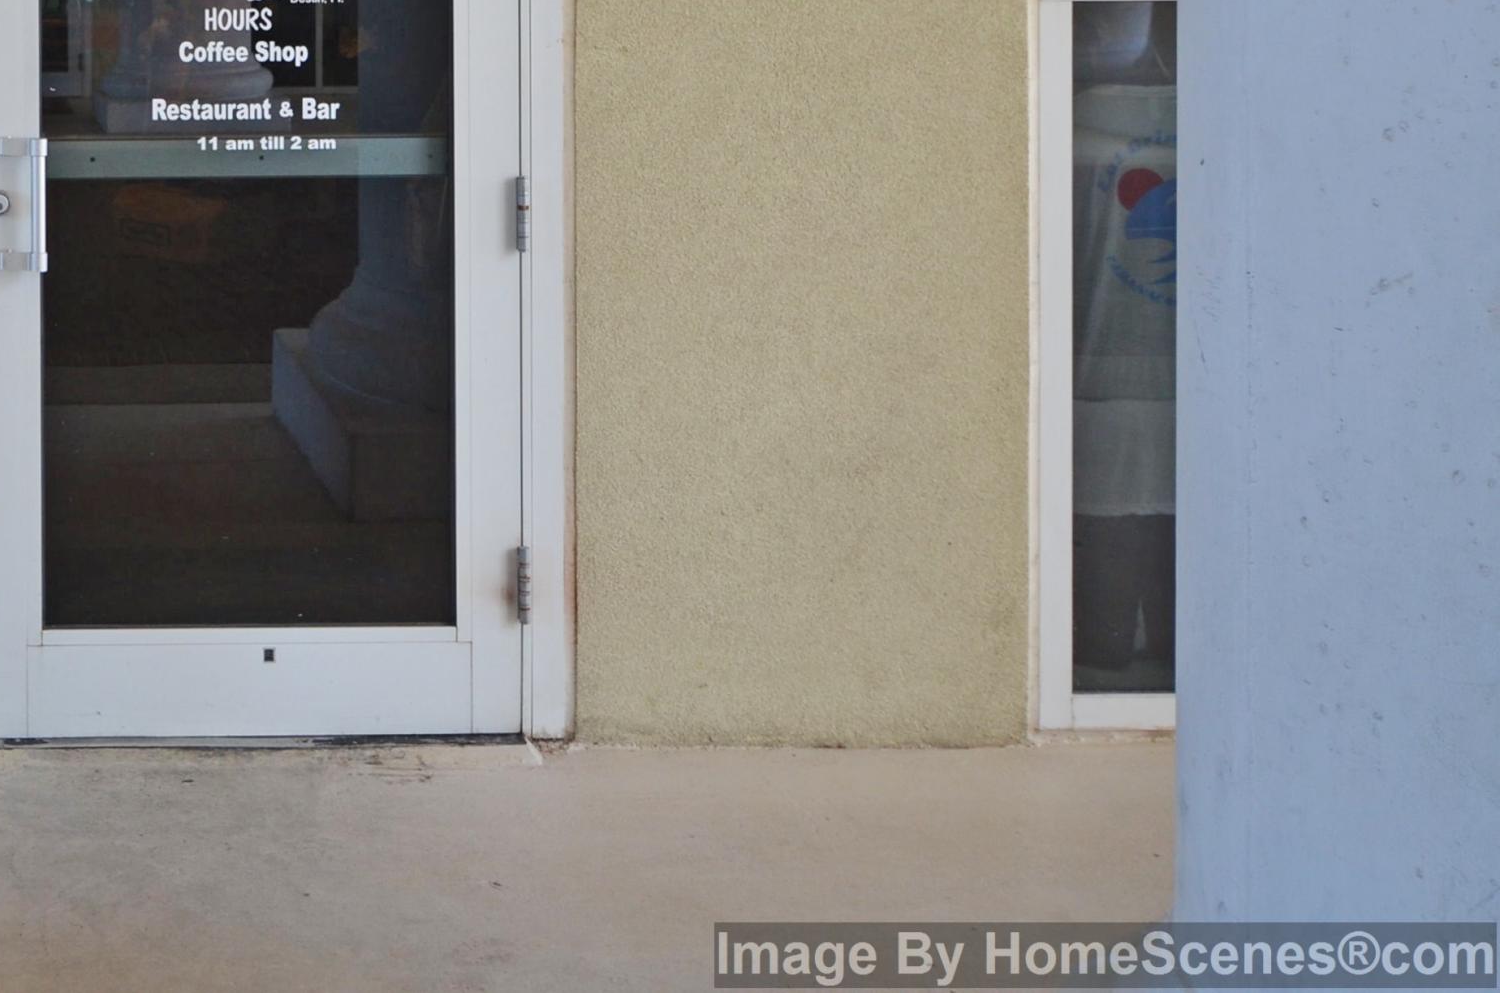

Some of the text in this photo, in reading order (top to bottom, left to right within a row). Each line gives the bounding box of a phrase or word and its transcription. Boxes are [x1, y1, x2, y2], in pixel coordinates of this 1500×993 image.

[204, 7, 273, 31] HOURS
[178, 40, 309, 67] Coffee Shop
[151, 97, 341, 122] Restaurant & Bar
[197, 136, 337, 151] 11 am till 2 am
